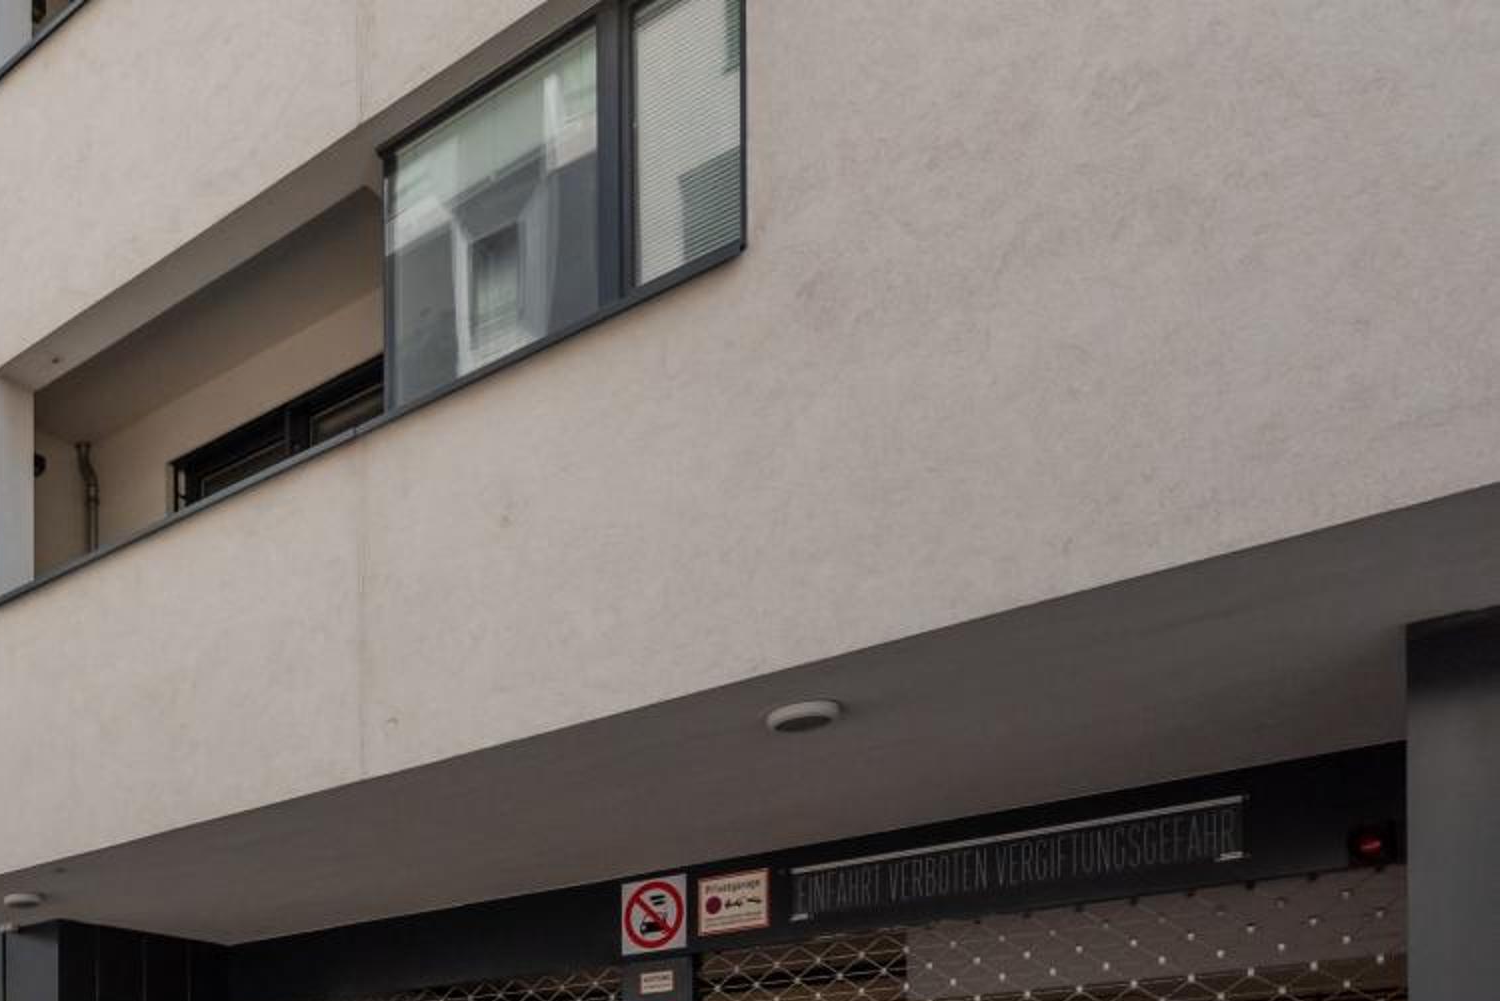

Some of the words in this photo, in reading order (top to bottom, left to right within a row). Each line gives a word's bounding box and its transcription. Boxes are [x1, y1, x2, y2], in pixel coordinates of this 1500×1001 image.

[796, 866, 881, 912] EINFAHRT
[888, 849, 988, 899] VERBOTEN
[995, 811, 1238, 888] VERGIFTUNGSGEFAHR
